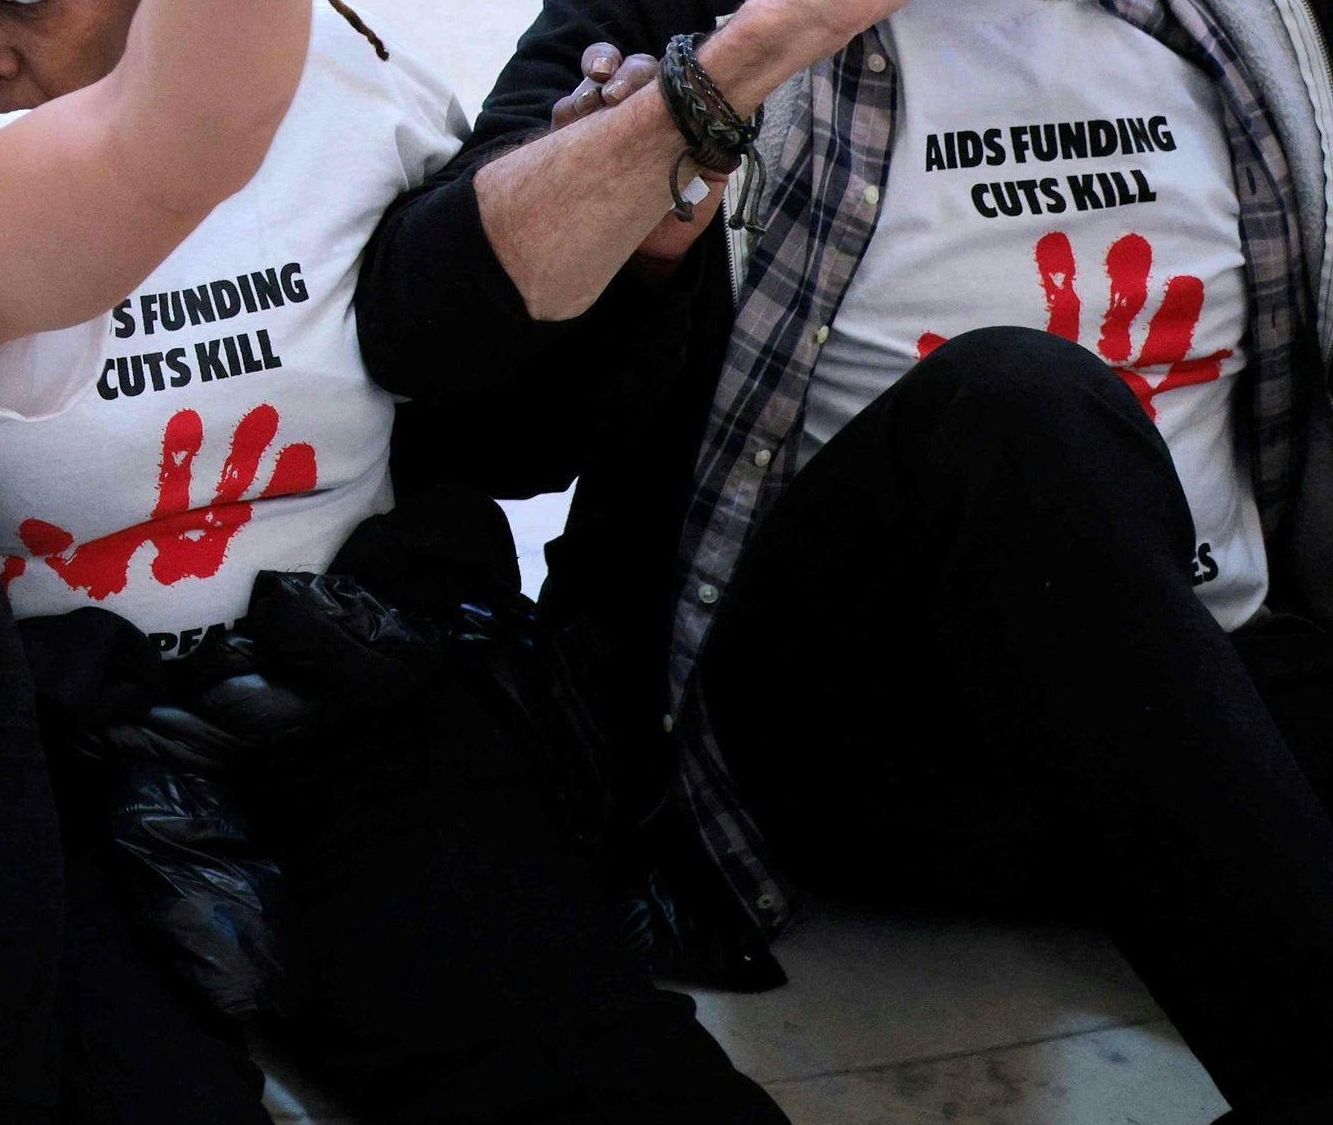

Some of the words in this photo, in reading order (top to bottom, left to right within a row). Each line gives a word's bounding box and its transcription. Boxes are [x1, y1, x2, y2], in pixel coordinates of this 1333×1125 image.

[925, 128, 1006, 172] AIDS
[1010, 116, 1177, 164] FUNDING
[971, 177, 1067, 218] CUTS
[1066, 170, 1157, 211] KILL
[140, 262, 309, 335] FUNDING
[96, 348, 192, 400] CUTS
[194, 329, 282, 382] KILL
